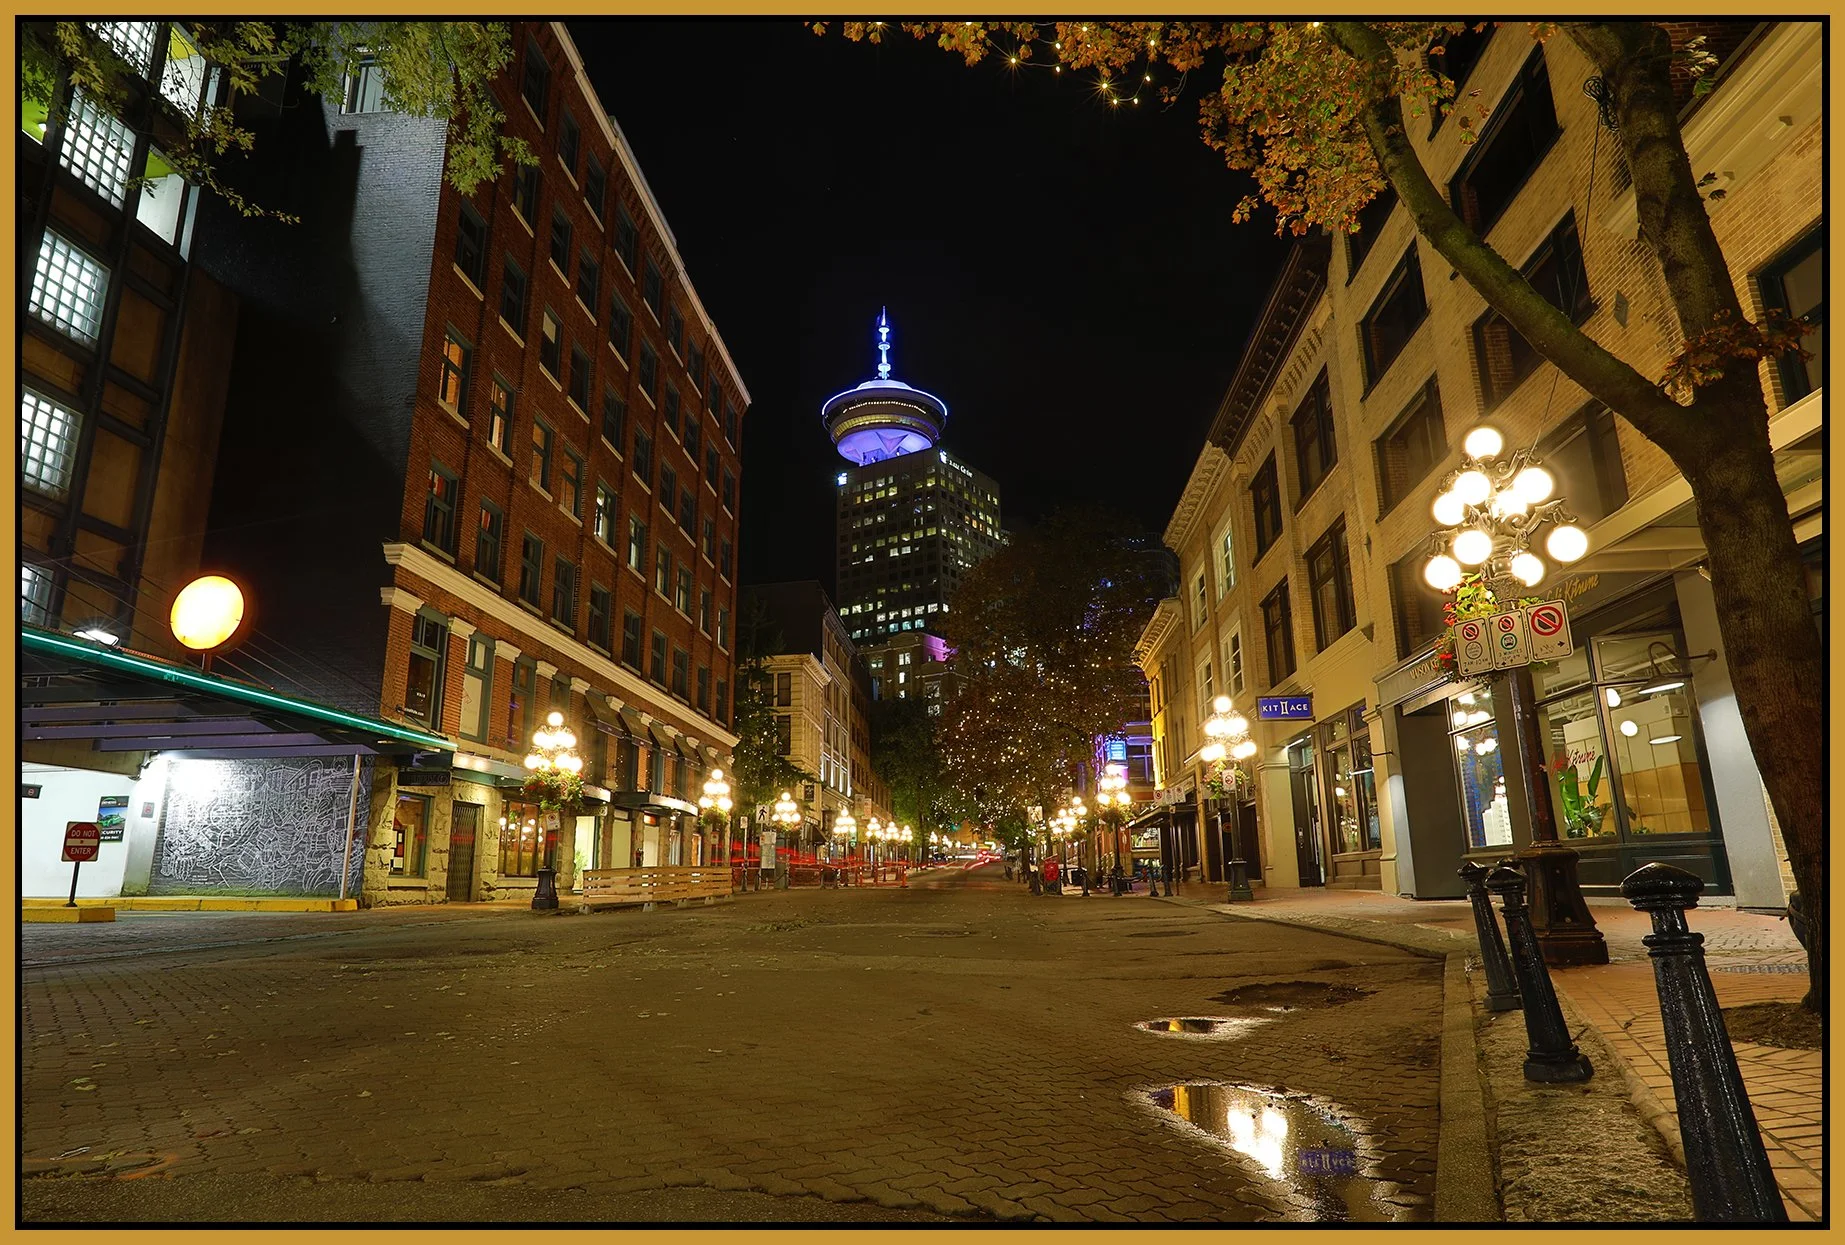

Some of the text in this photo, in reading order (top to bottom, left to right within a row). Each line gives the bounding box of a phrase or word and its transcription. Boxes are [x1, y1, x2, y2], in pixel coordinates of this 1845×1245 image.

[1262, 703, 1308, 712] KIT ACE
[71, 829, 81, 837] DO
[82, 829, 96, 838] NOT
[70, 847, 92, 855] ENTER
